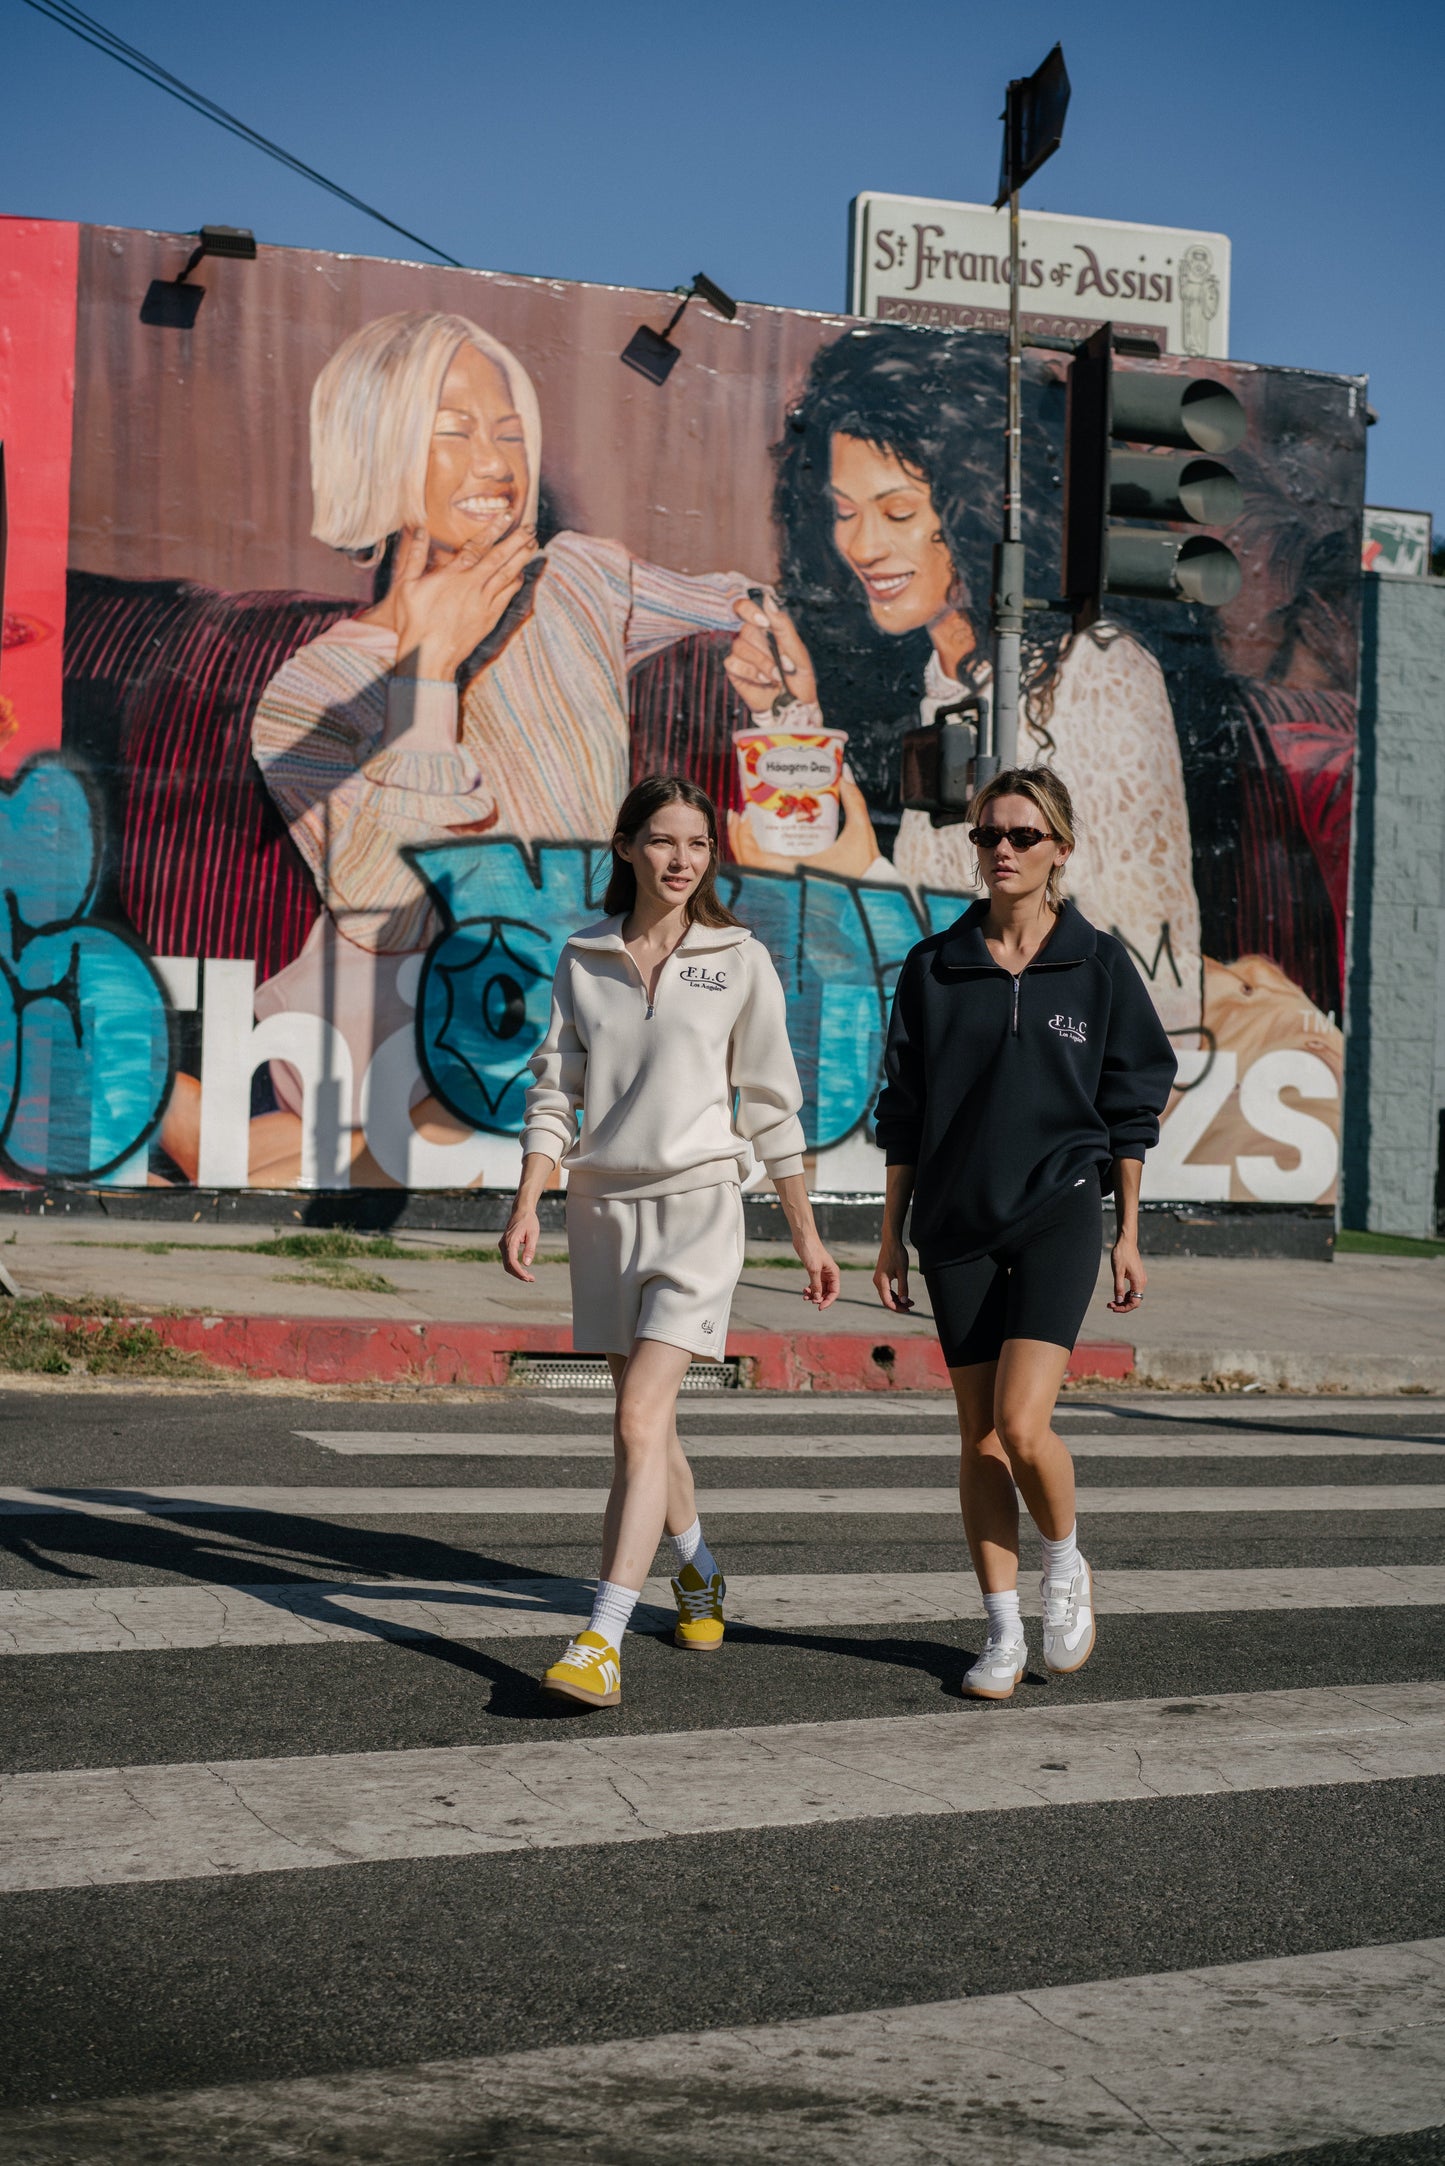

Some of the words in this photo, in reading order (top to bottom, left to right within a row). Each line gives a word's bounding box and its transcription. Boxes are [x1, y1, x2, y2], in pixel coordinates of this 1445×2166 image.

[904, 223, 1043, 291] Francis
[1073, 244, 1173, 303] Assisi
[701, 983, 722, 991] Angeles
[1298, 1008, 1335, 1035] TM
